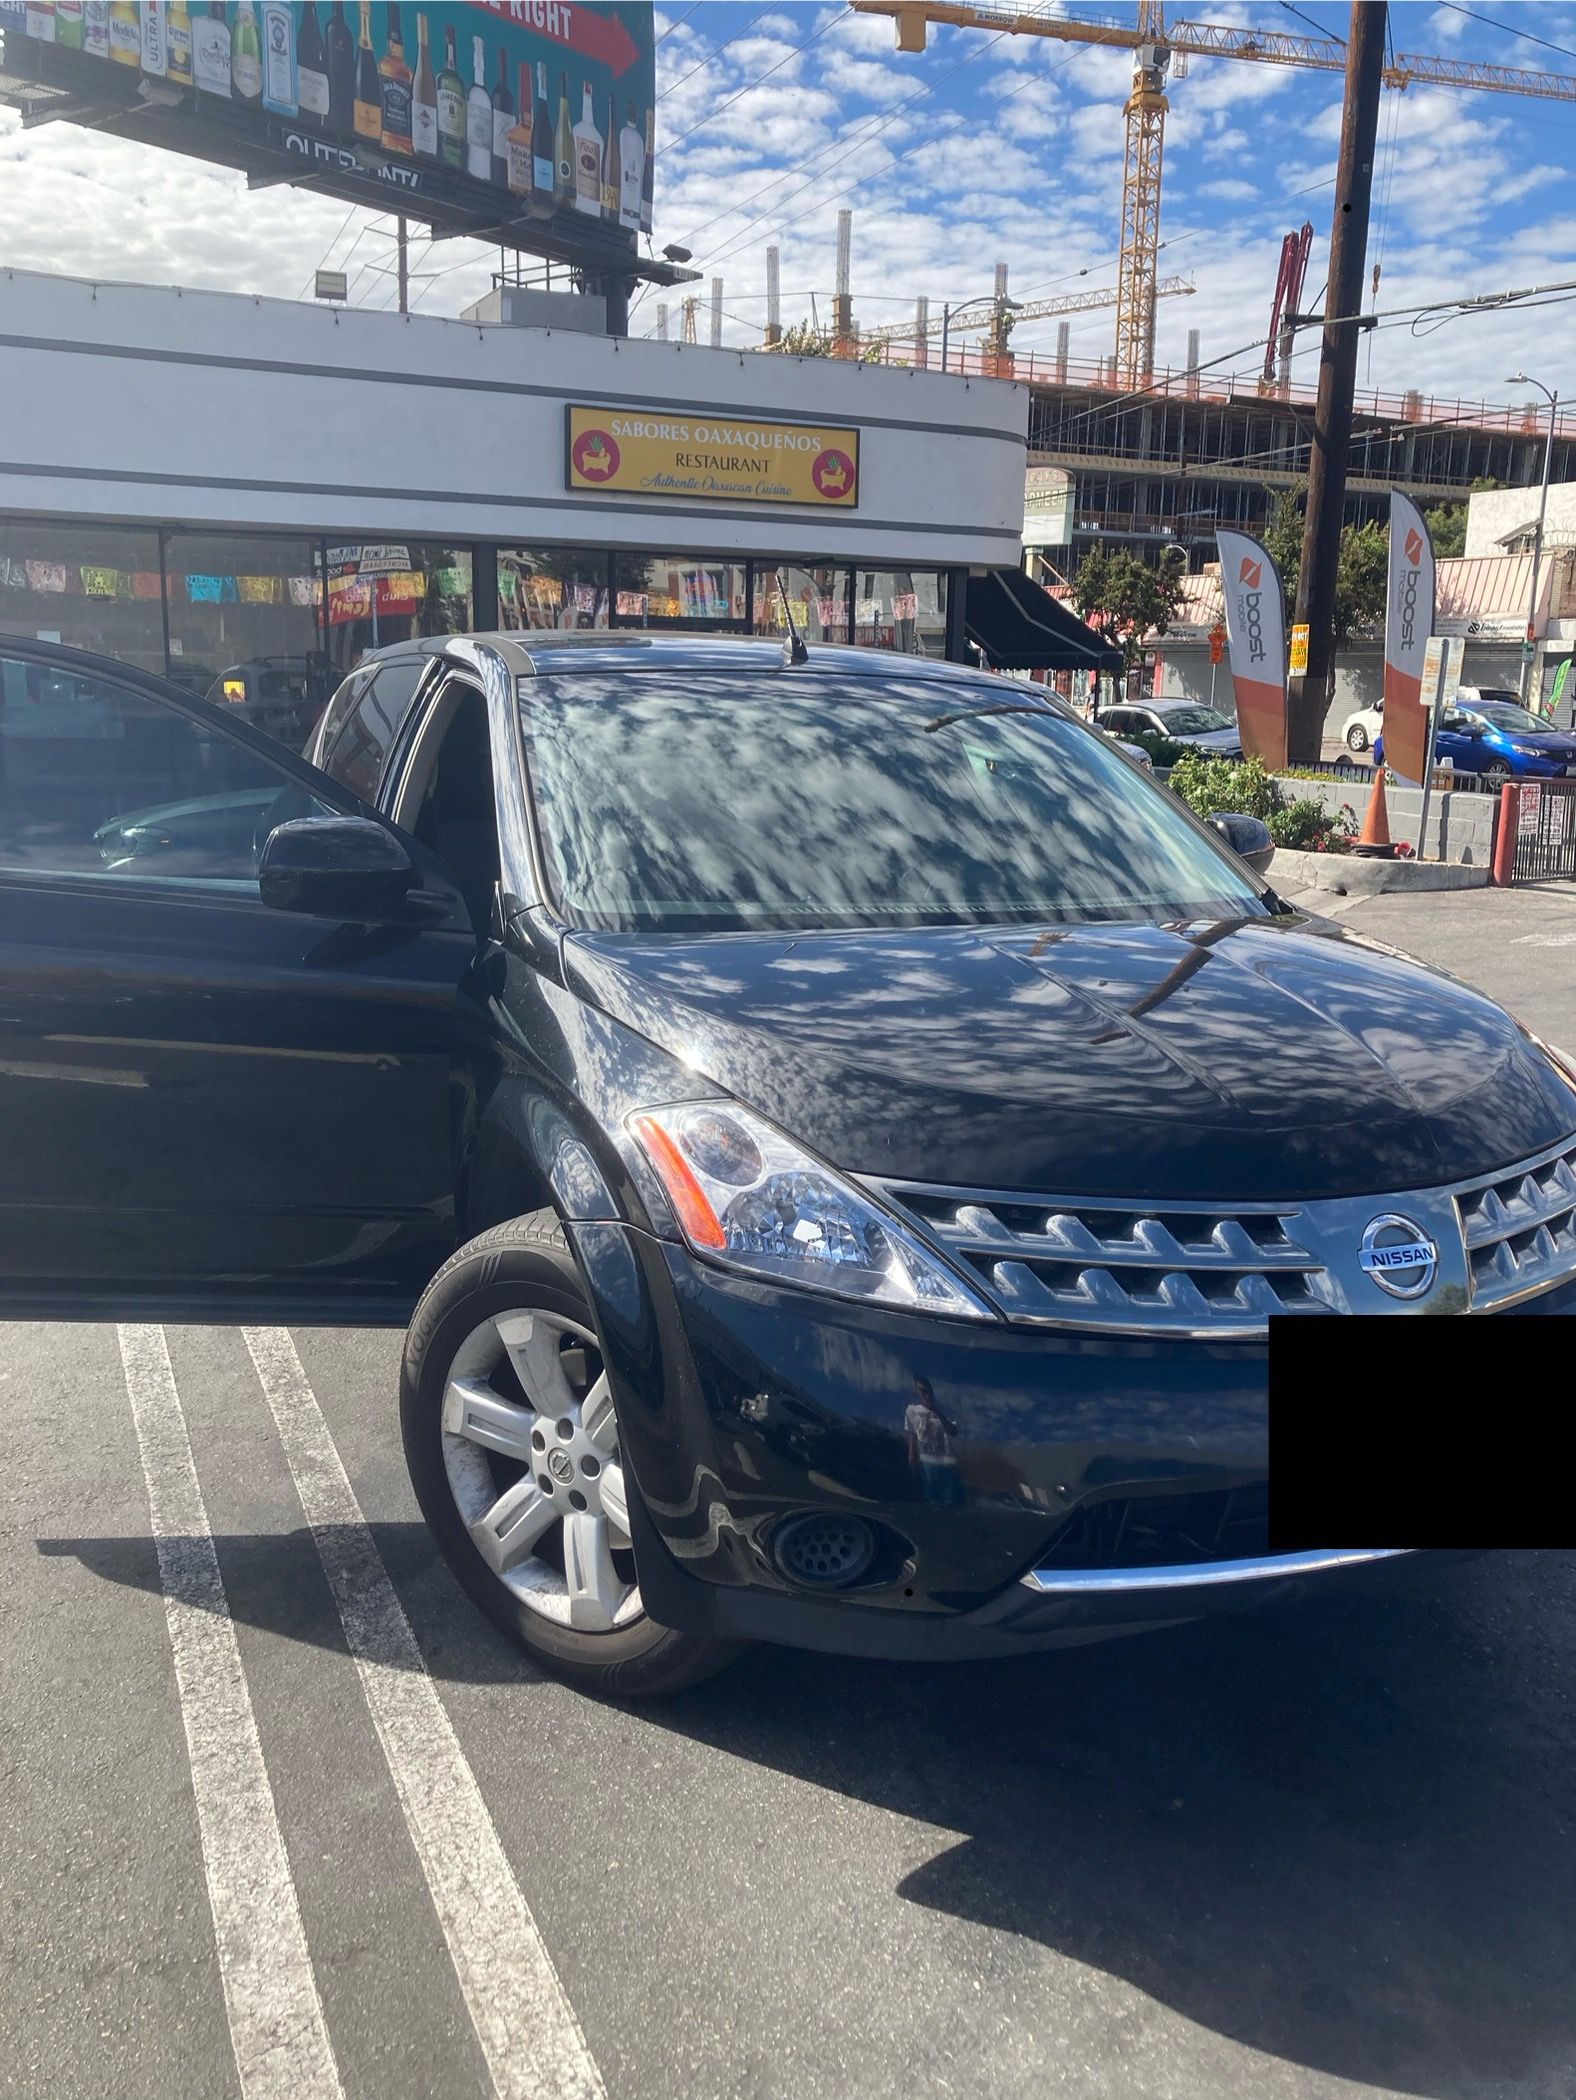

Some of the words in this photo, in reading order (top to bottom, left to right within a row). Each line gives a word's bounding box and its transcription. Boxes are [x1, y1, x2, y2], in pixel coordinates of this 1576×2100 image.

[510, 0, 572, 40] RIGHT
[984, 13, 1014, 23] MORROW
[149, 16, 158, 61] ULTRA
[610, 419, 690, 442] SABORES
[695, 427, 822, 452] OAXAQUEÑOS
[675, 453, 771, 474] RESTAURANT
[640, 472, 700, 491] Authentic
[702, 476, 752, 495] Oaxacan
[755, 480, 793, 496] Cuisine
[1397, 569, 1407, 614] mobile
[1401, 570, 1421, 651] boost
[1237, 594, 1247, 634] mobile
[1246, 592, 1267, 663] boost
[1371, 1246, 1434, 1267] NISSAN
